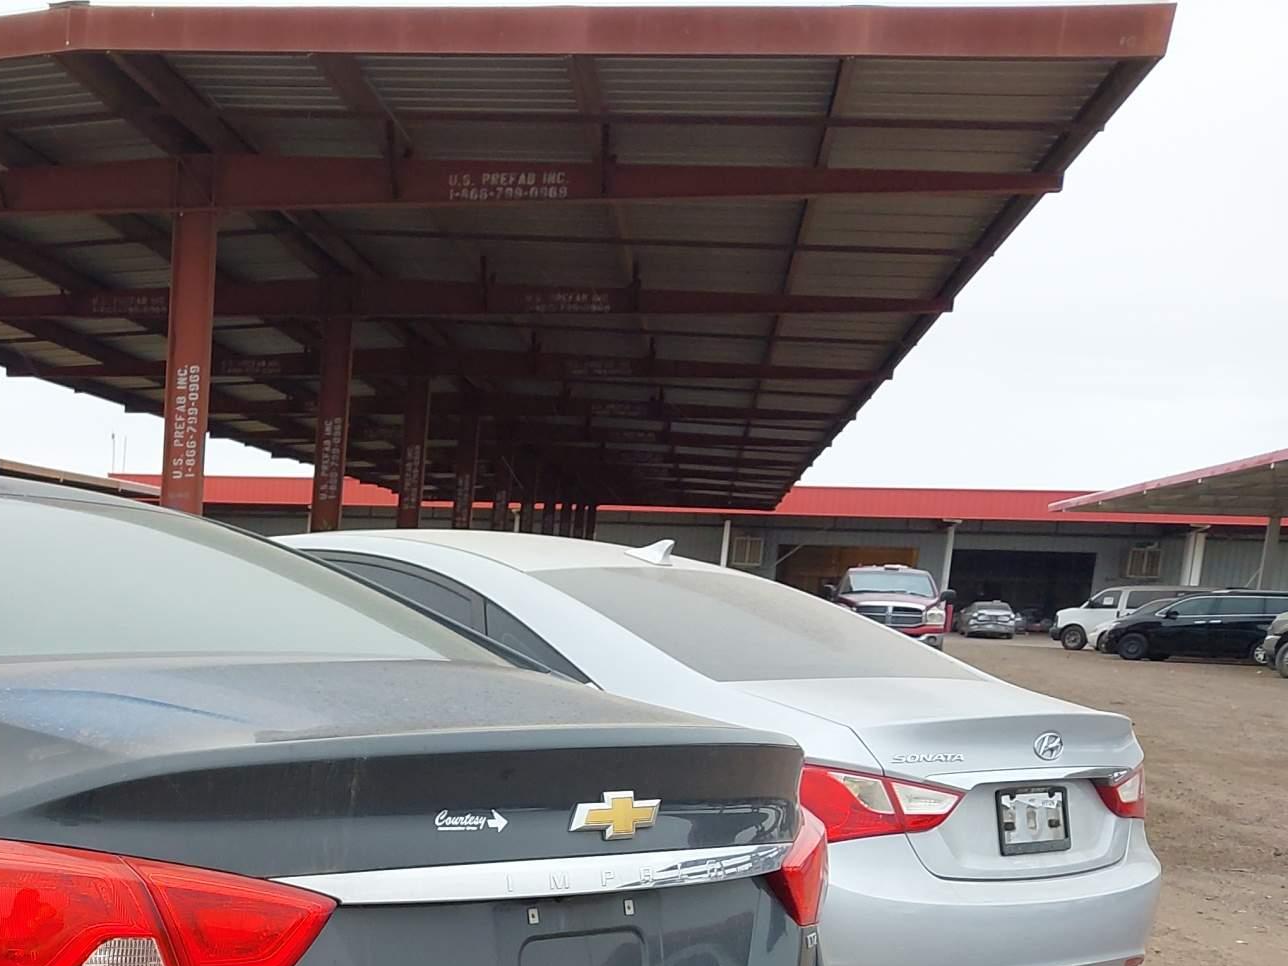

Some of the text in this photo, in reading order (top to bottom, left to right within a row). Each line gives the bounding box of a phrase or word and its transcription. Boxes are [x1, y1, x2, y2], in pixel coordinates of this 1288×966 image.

[172, 365, 188, 479] U.S. PREFAB INC.
[185, 365, 200, 477] 1-866-799-0969
[889, 753, 965, 763] SONATA
[435, 809, 487, 830] Courtesy
